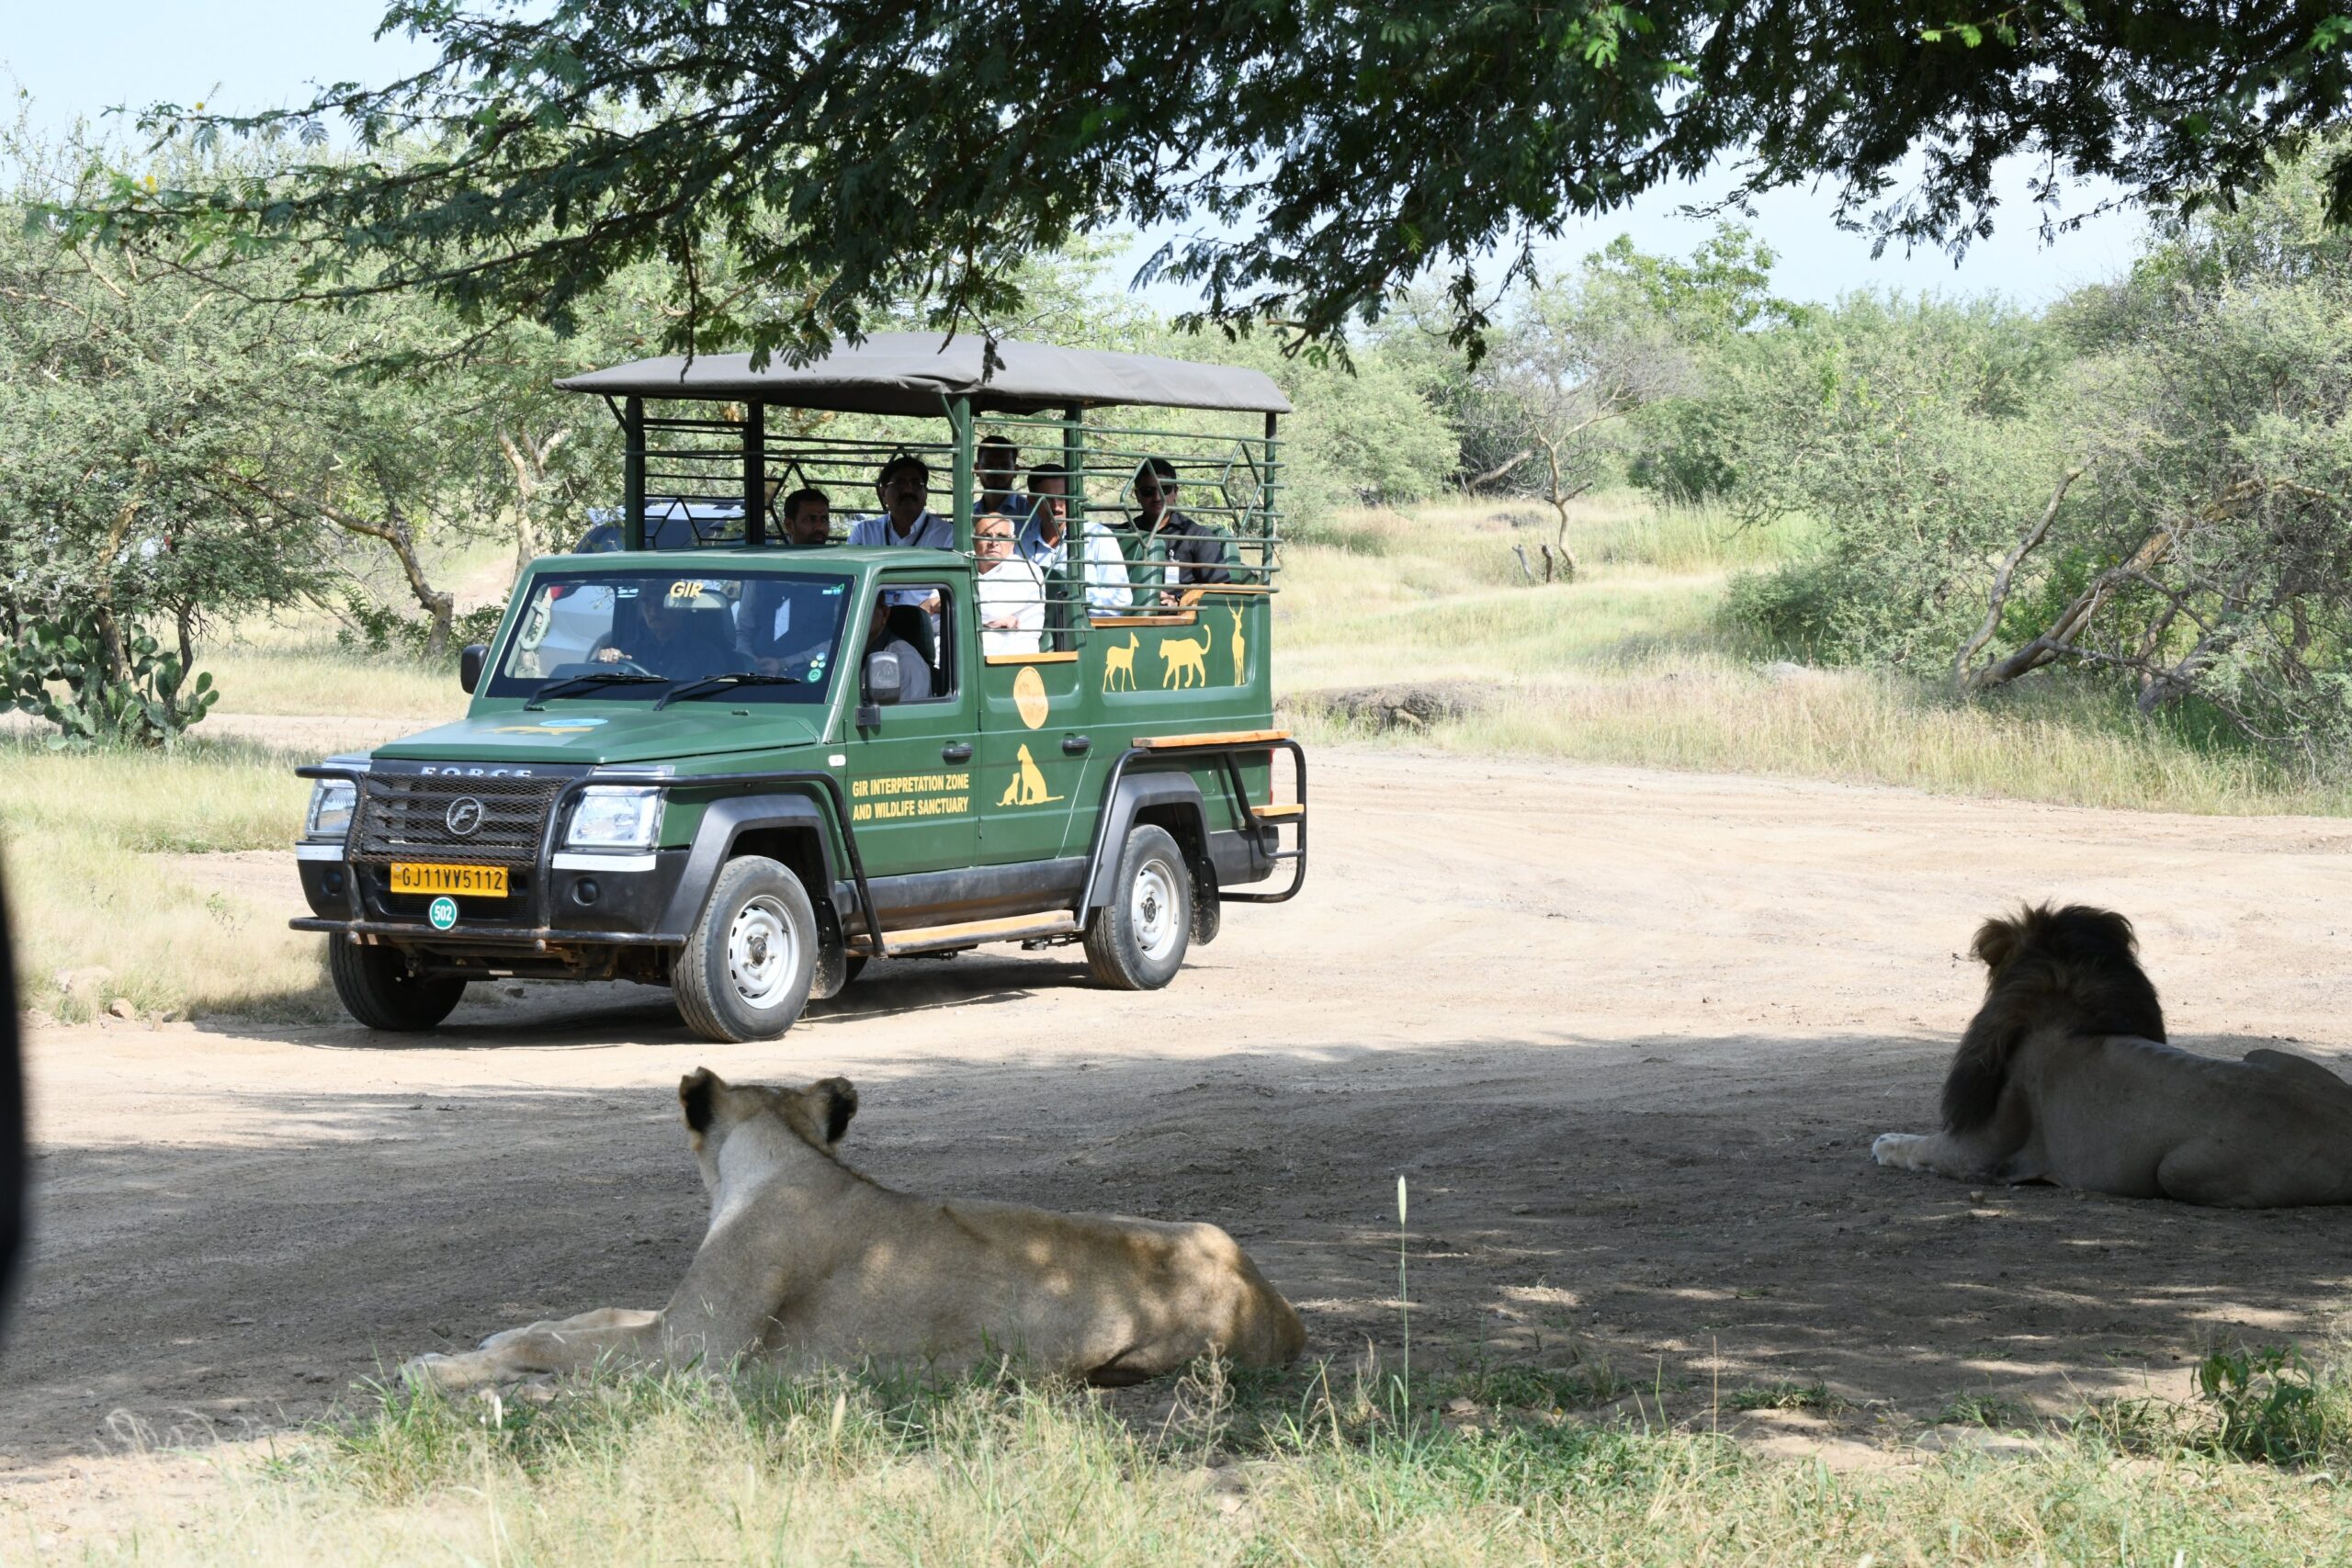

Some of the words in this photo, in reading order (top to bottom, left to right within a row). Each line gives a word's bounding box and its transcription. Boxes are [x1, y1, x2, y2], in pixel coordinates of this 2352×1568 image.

[670, 581, 703, 598] GIR
[421, 766, 532, 777] FORCE
[853, 780, 869, 797] GIR
[870, 775, 944, 795] INTERPRETATION
[945, 773, 969, 790] ZONE
[853, 804, 872, 820] AND
[875, 800, 915, 818] WILDLIFE
[917, 796, 969, 815] SANCTUARY
[402, 867, 503, 890] GJ11VV5112
[435, 905, 452, 921] 502
